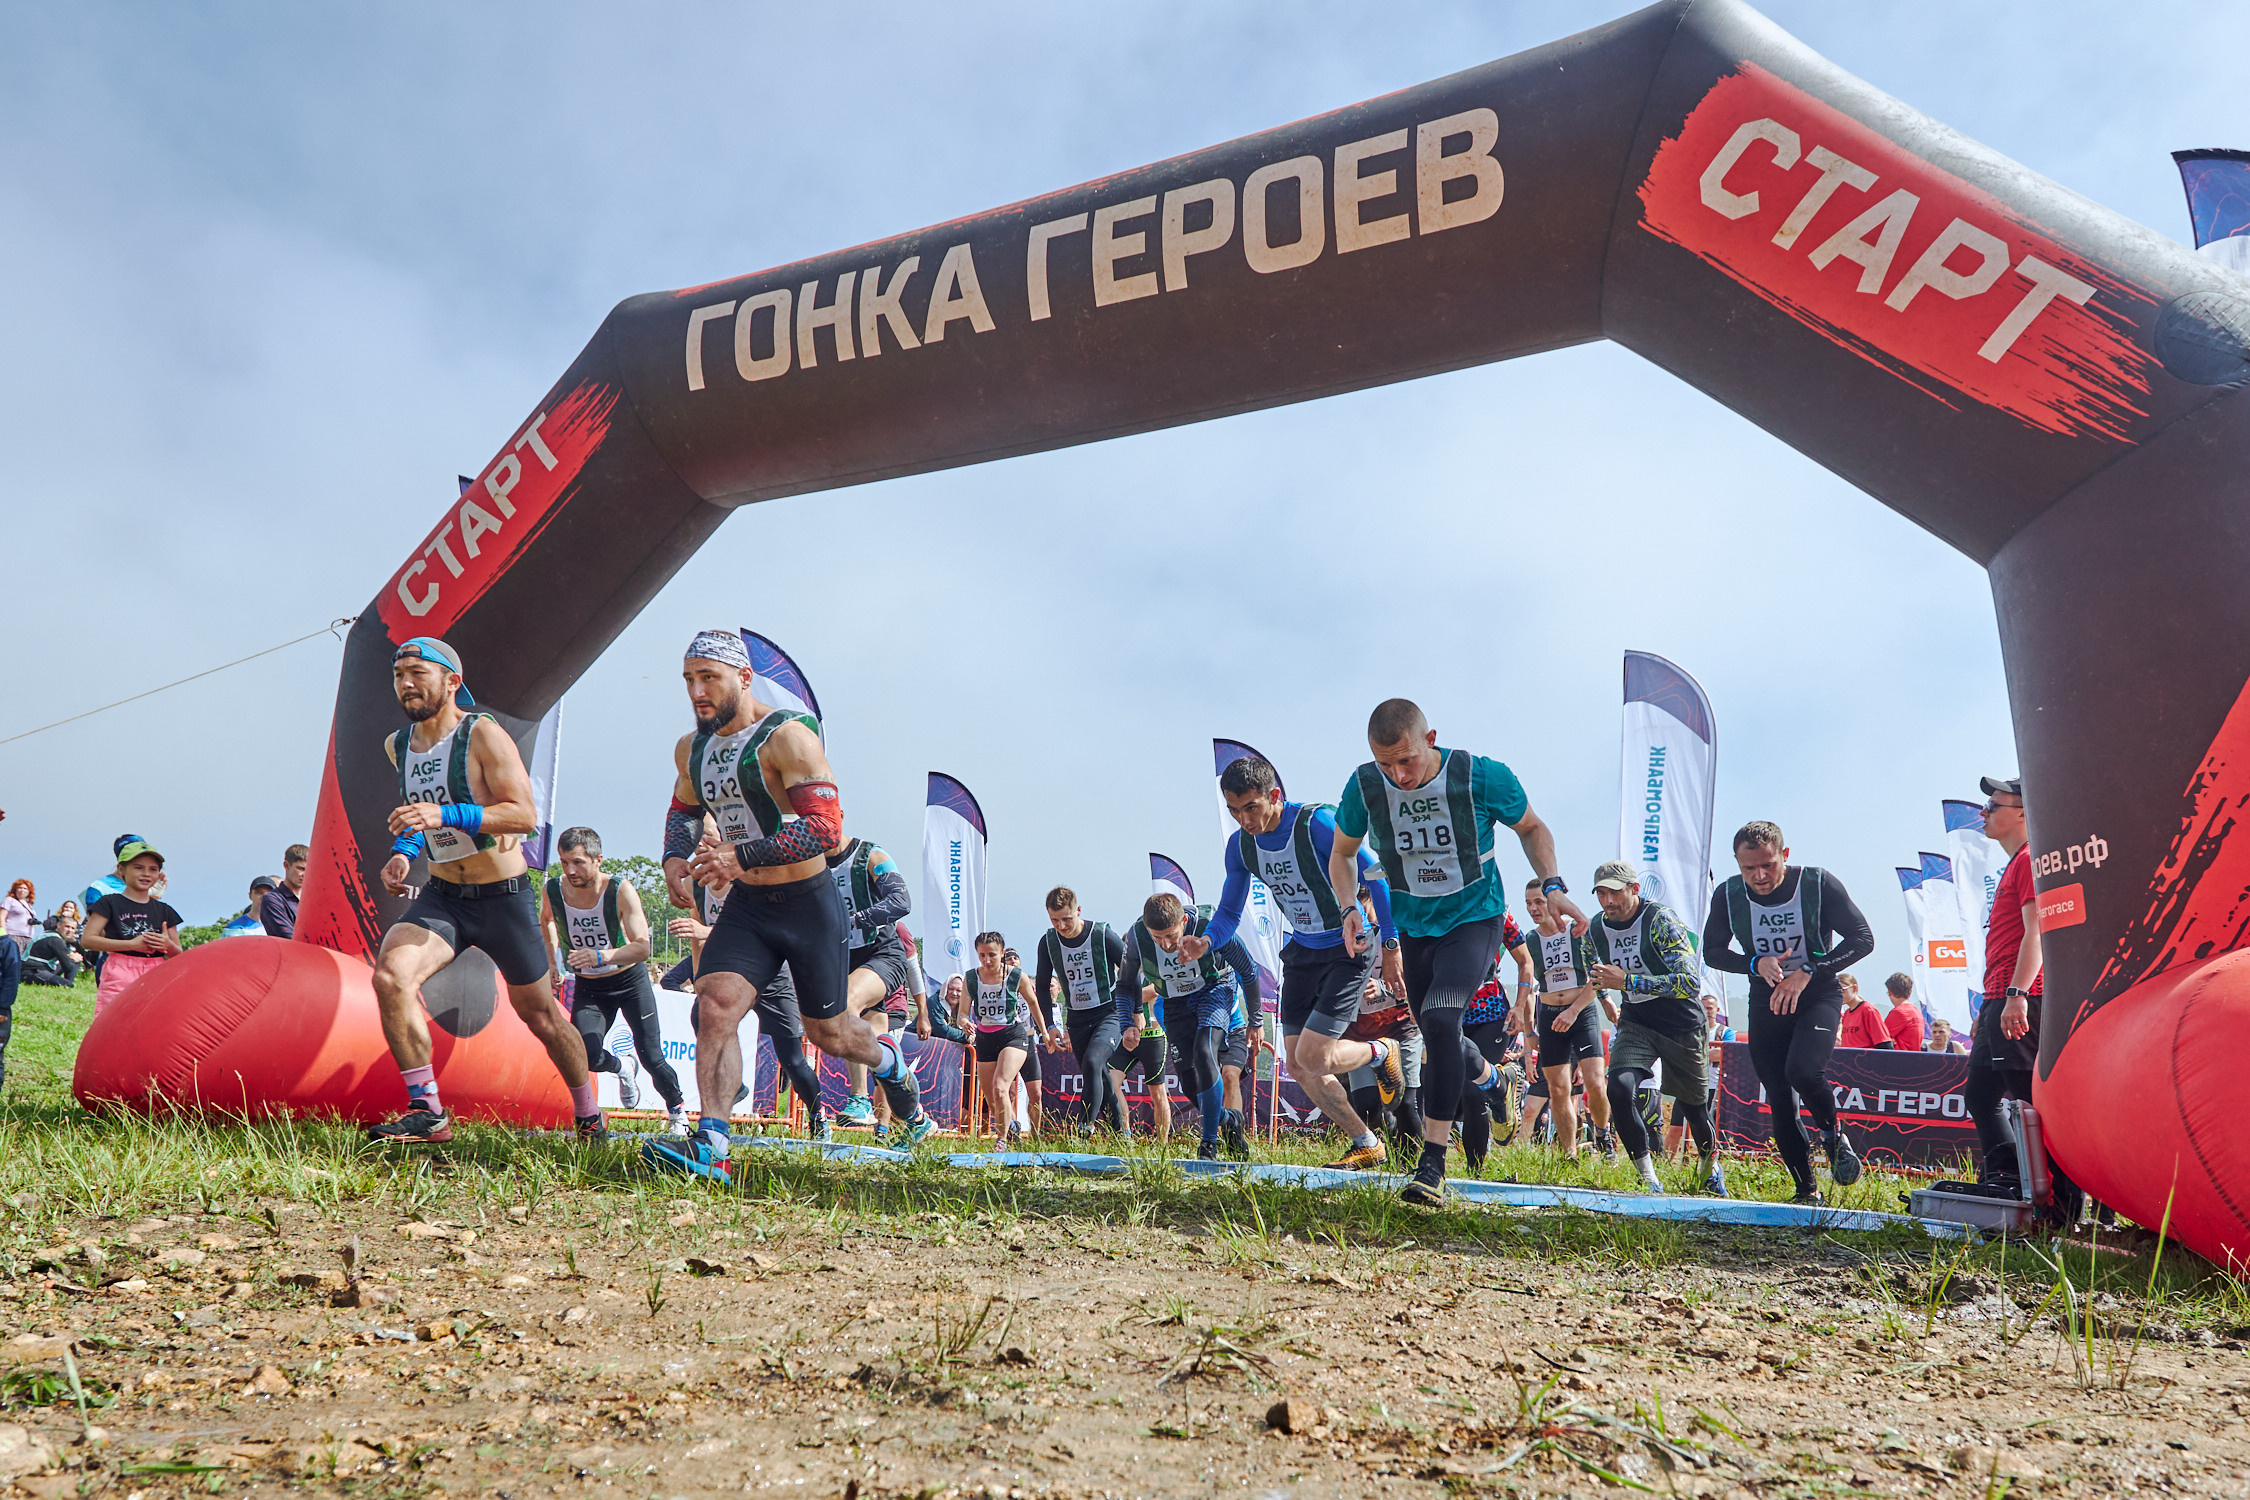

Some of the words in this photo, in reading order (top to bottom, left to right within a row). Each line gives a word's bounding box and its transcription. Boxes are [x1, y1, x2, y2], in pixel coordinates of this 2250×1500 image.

[1699, 117, 2097, 364] СТАРТ
[685, 242, 996, 391] ГОНКА
[1026, 107, 1506, 322] ГЕРОЕВ
[397, 411, 559, 617] СТАРТ
[707, 748, 738, 766] AGE
[410, 758, 442, 778] AGE
[409, 785, 450, 806] 302
[1398, 796, 1440, 818] AGE
[1411, 814, 1431, 824] 30-34
[724, 823, 746, 832] ГОНКА
[1397, 824, 1452, 852] 318
[1265, 860, 1293, 875] AGE
[1418, 867, 1444, 875] ГОНКА
[1418, 874, 1448, 883] ГЕРОЕВ
[1269, 882, 1309, 896] 304
[573, 916, 600, 927] AGE
[1759, 911, 1795, 926] AGE
[572, 933, 608, 948] 305
[1545, 936, 1567, 950] AGE
[1614, 935, 1638, 949] AGE
[1756, 935, 1802, 954] 307
[1067, 951, 1089, 963] AGE
[1164, 956, 1180, 967] AG
[1066, 967, 1094, 981] 315
[981, 991, 1002, 1000] AGE
[980, 1005, 1005, 1016] 306
